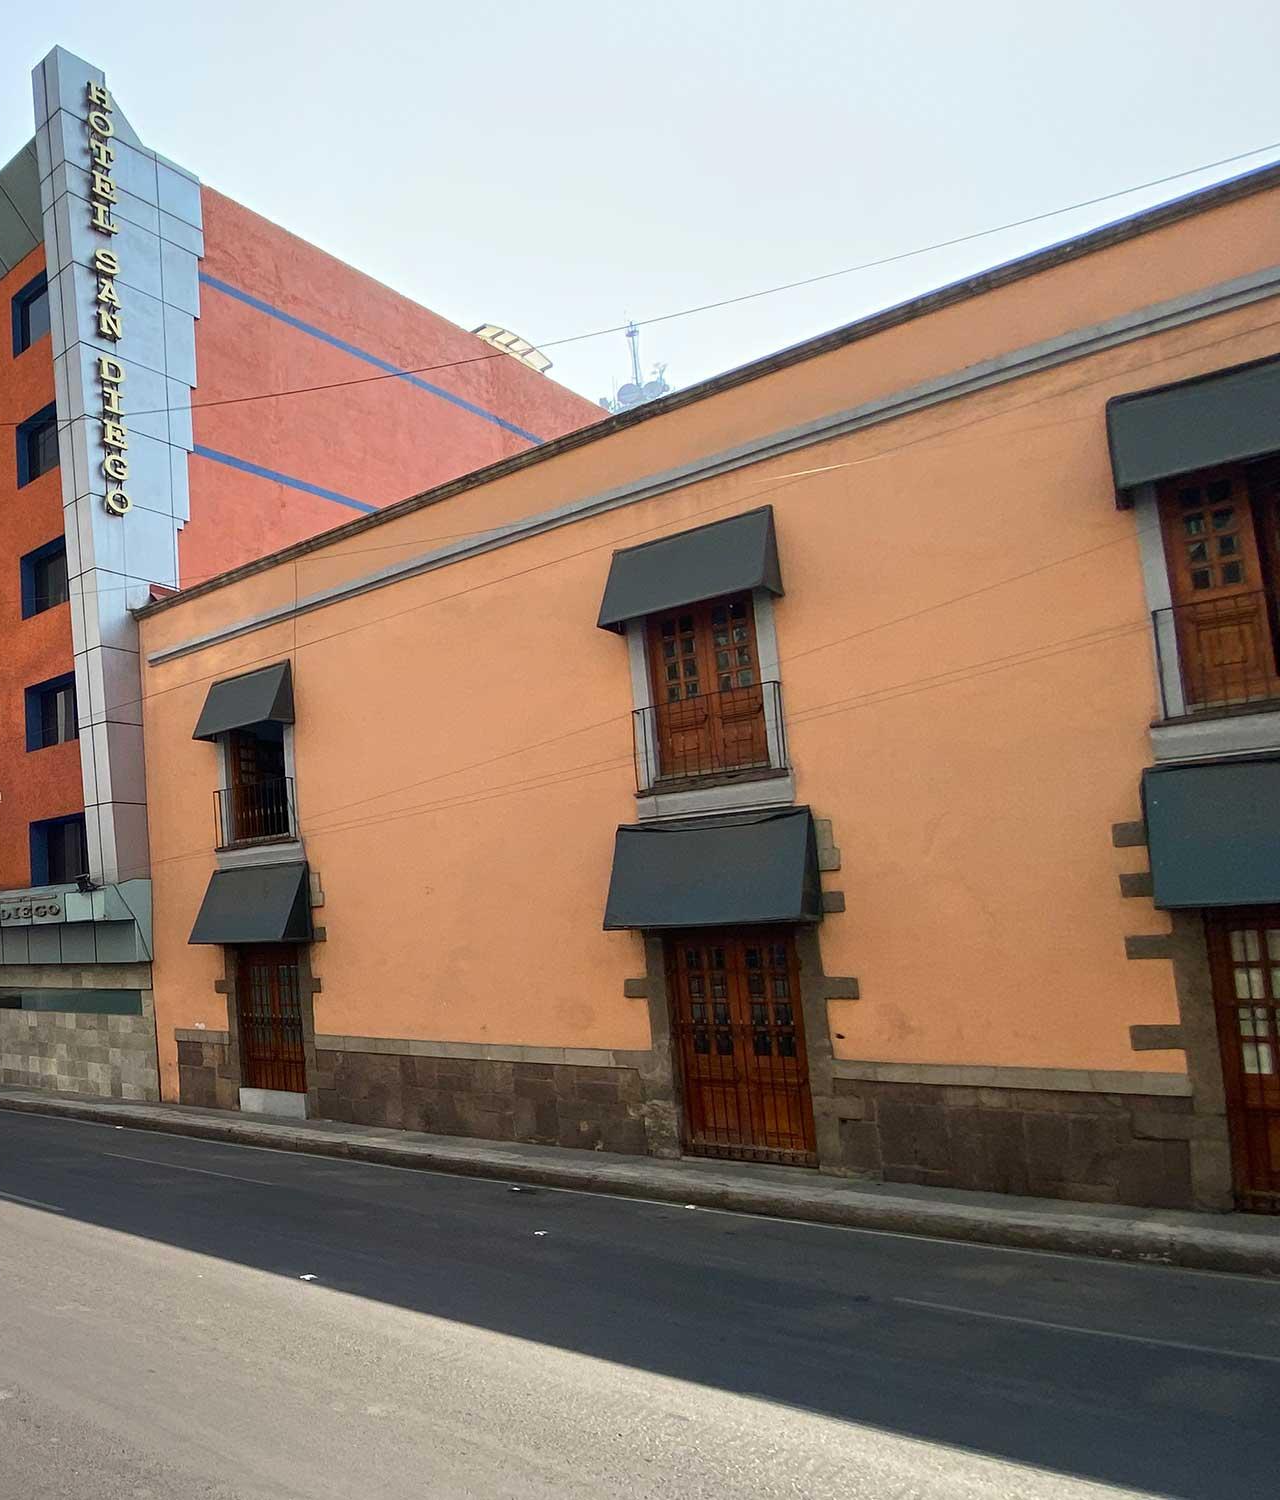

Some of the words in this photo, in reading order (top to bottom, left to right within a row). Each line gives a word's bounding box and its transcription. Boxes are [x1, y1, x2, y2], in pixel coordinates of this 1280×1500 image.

[87, 80, 118, 235] HOTEL
[95, 248, 122, 341] SAN
[97, 357, 133, 515] DIEGO
[0, 903, 60, 920] DIEGO
